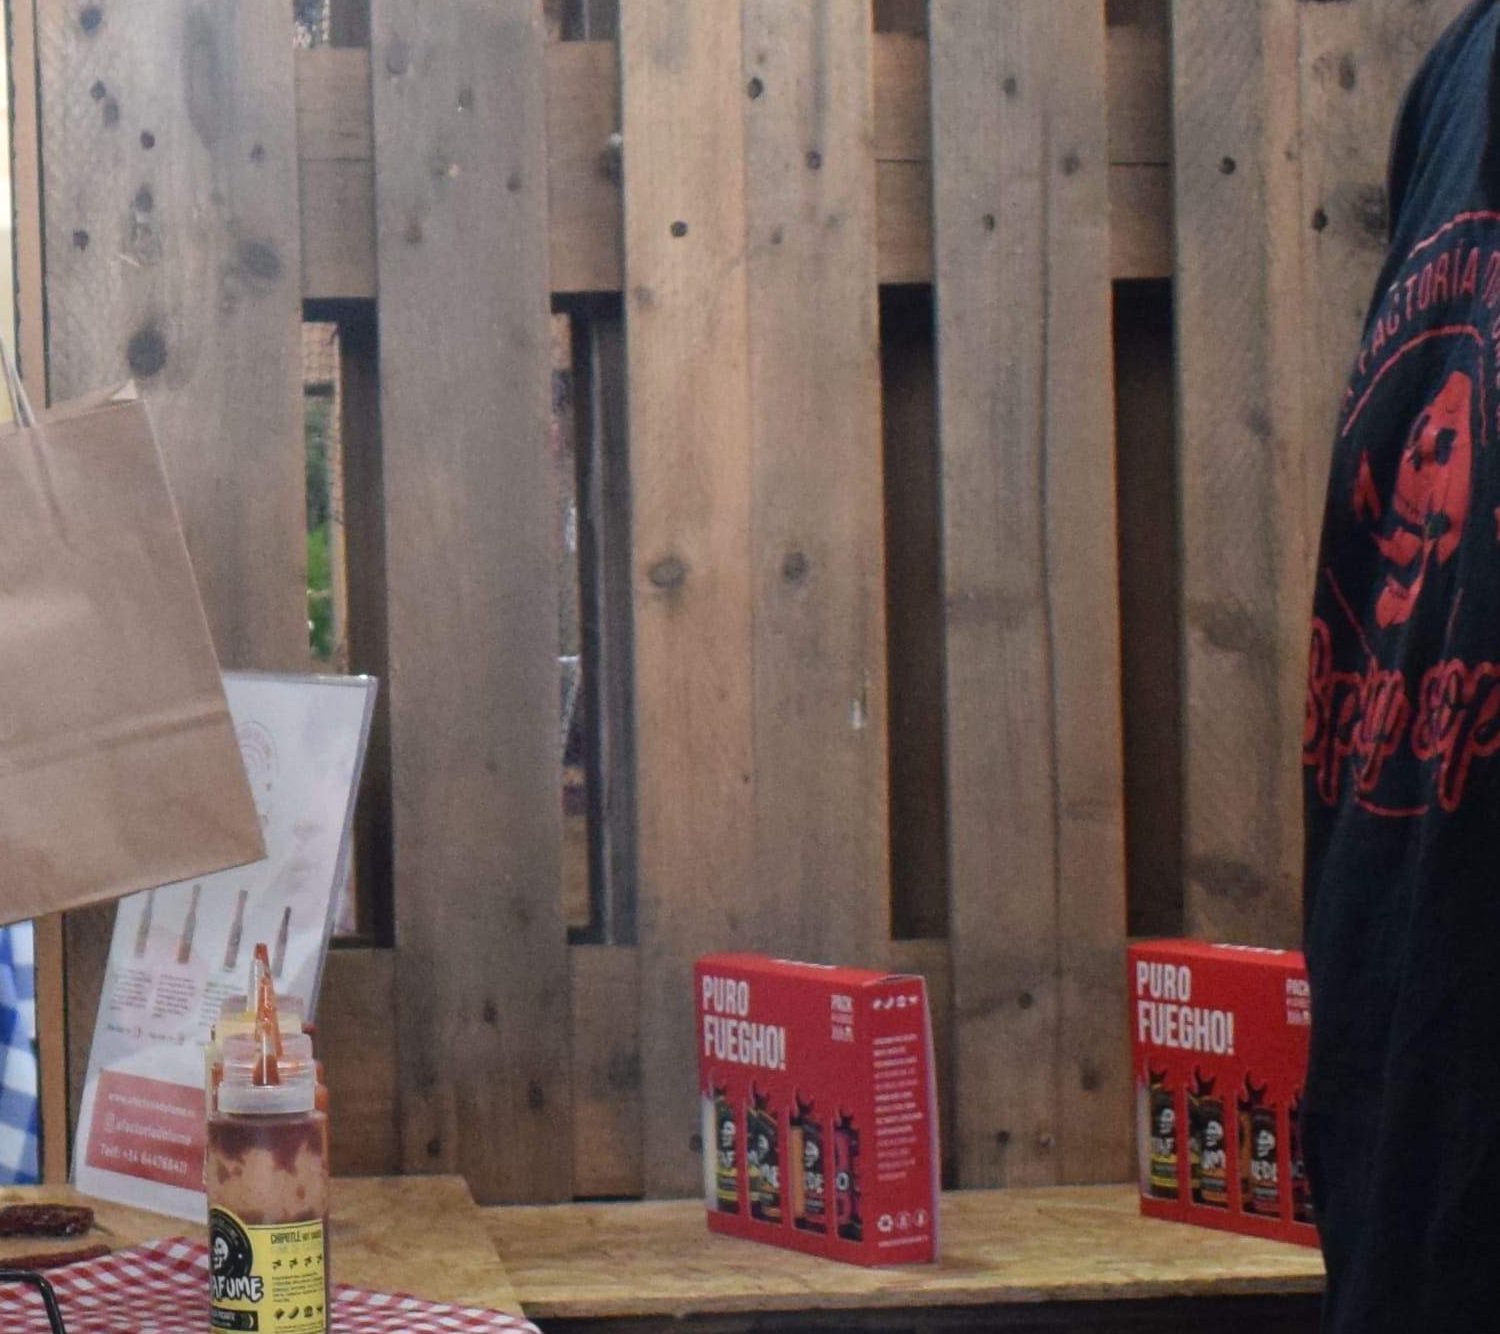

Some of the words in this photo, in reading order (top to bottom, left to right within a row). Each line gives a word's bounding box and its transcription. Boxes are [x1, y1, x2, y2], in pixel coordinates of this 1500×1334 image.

[702, 975, 750, 1017] PURO
[1136, 960, 1192, 1002] PURO
[703, 1014, 786, 1071] FUEGHO!
[1137, 999, 1235, 1056] FUEGHO!
